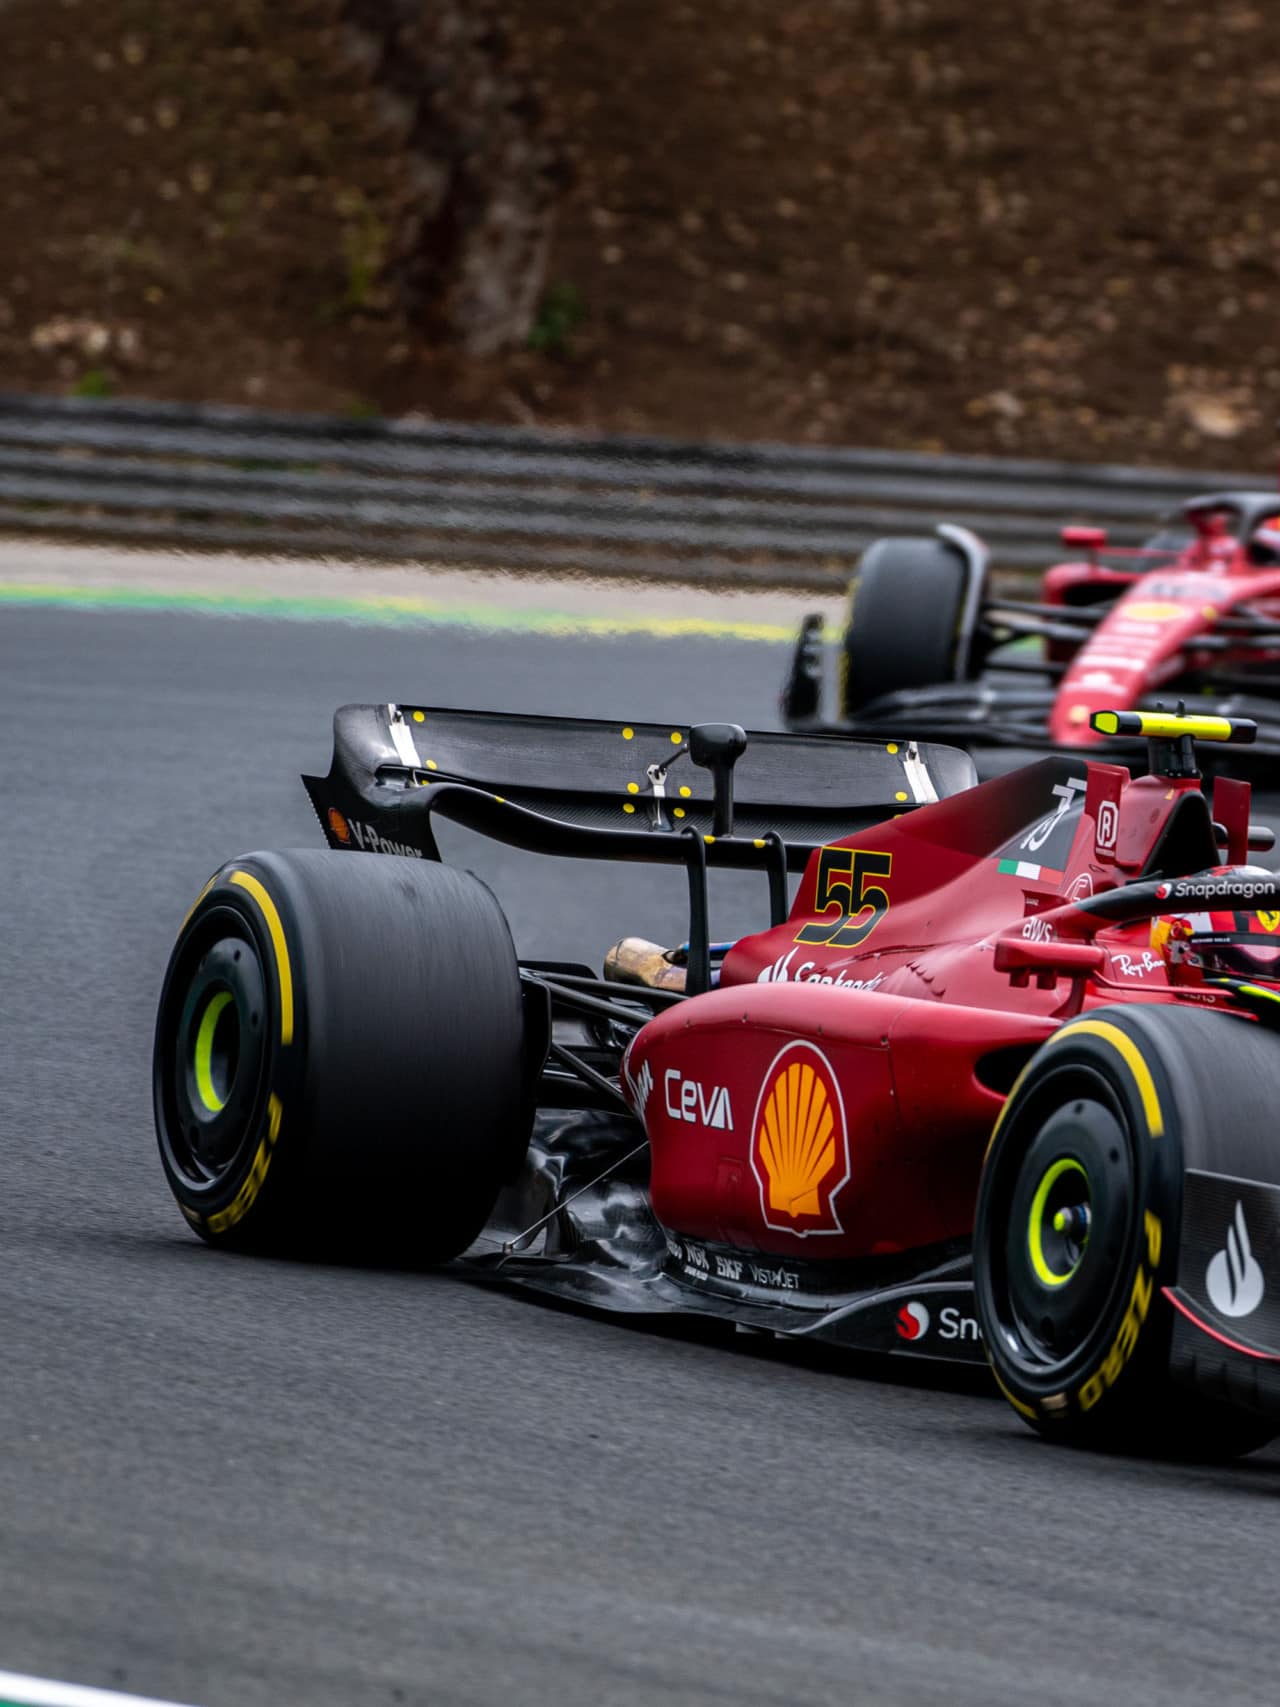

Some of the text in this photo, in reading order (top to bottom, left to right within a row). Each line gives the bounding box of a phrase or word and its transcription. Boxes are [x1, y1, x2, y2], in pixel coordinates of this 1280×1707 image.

[792, 845, 893, 949] 55
[1175, 881, 1275, 899] Snapdragon
[1022, 917, 1053, 944] aws
[1111, 952, 1166, 978] Ray-Ban
[714, 1255, 744, 1281] SKF
